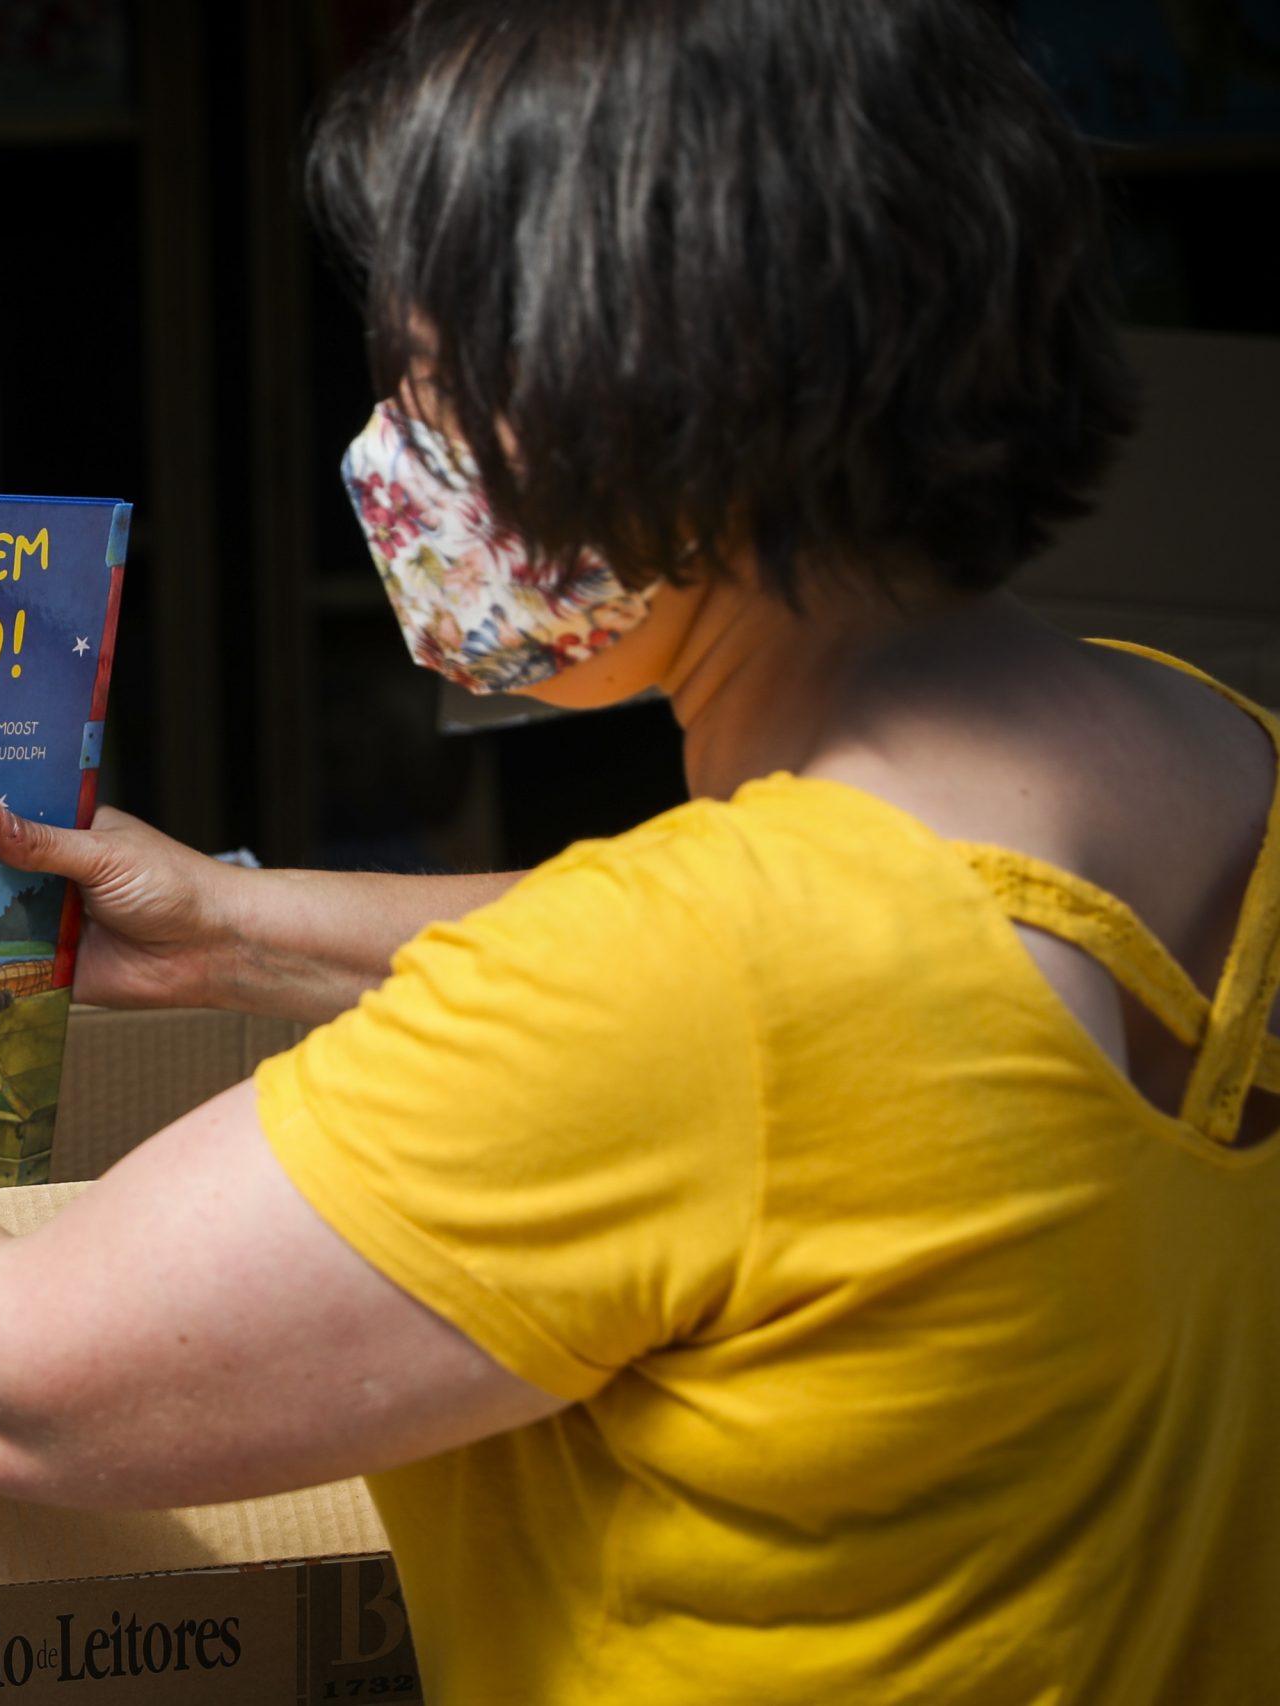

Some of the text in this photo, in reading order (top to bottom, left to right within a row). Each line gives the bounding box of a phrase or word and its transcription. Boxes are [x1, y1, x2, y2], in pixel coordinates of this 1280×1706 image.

[37, 1640, 58, 1669] de
[56, 1610, 241, 1681] Leitores
[323, 1675, 413, 1699] 1732
